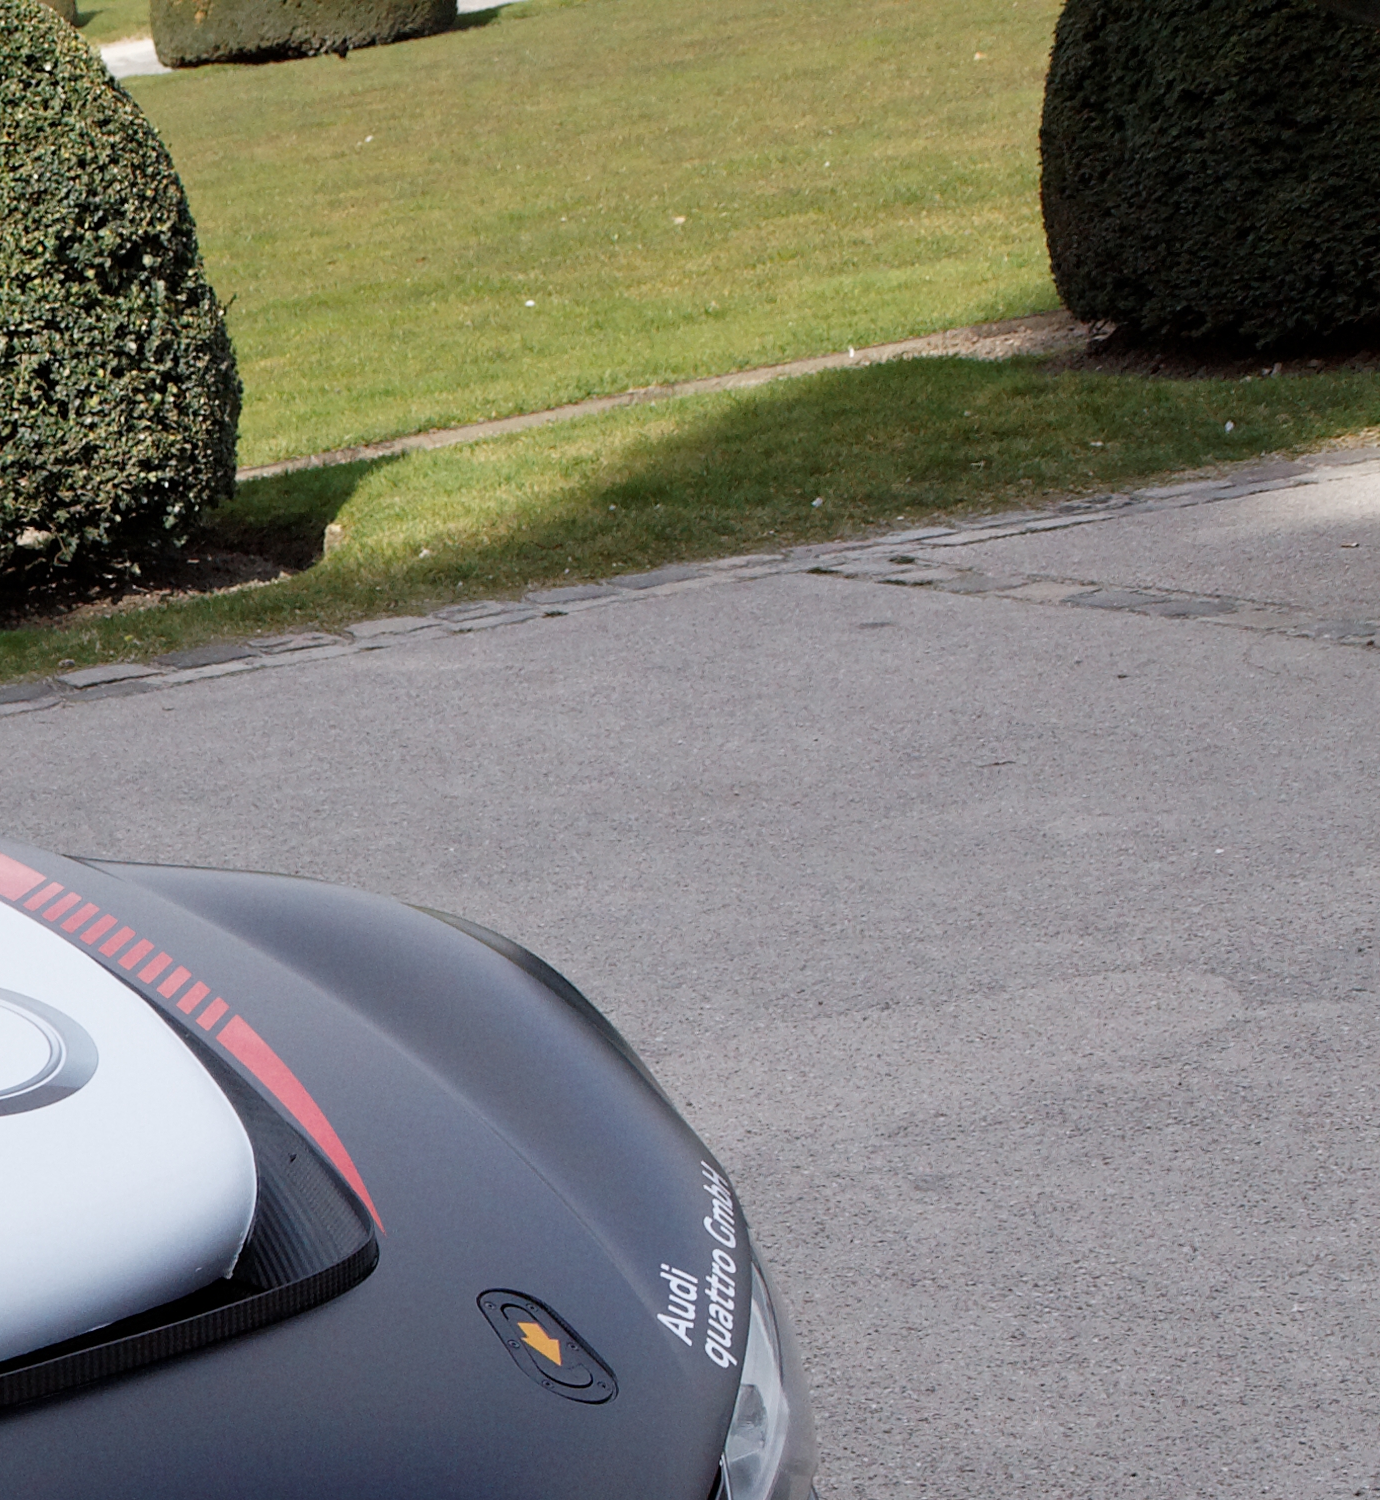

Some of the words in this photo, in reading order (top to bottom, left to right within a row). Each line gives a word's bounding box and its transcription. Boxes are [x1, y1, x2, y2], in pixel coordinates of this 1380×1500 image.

[700, 1160, 737, 1250] GmbH
[656, 1263, 699, 1346] Audi
[704, 1248, 737, 1370] quattro
